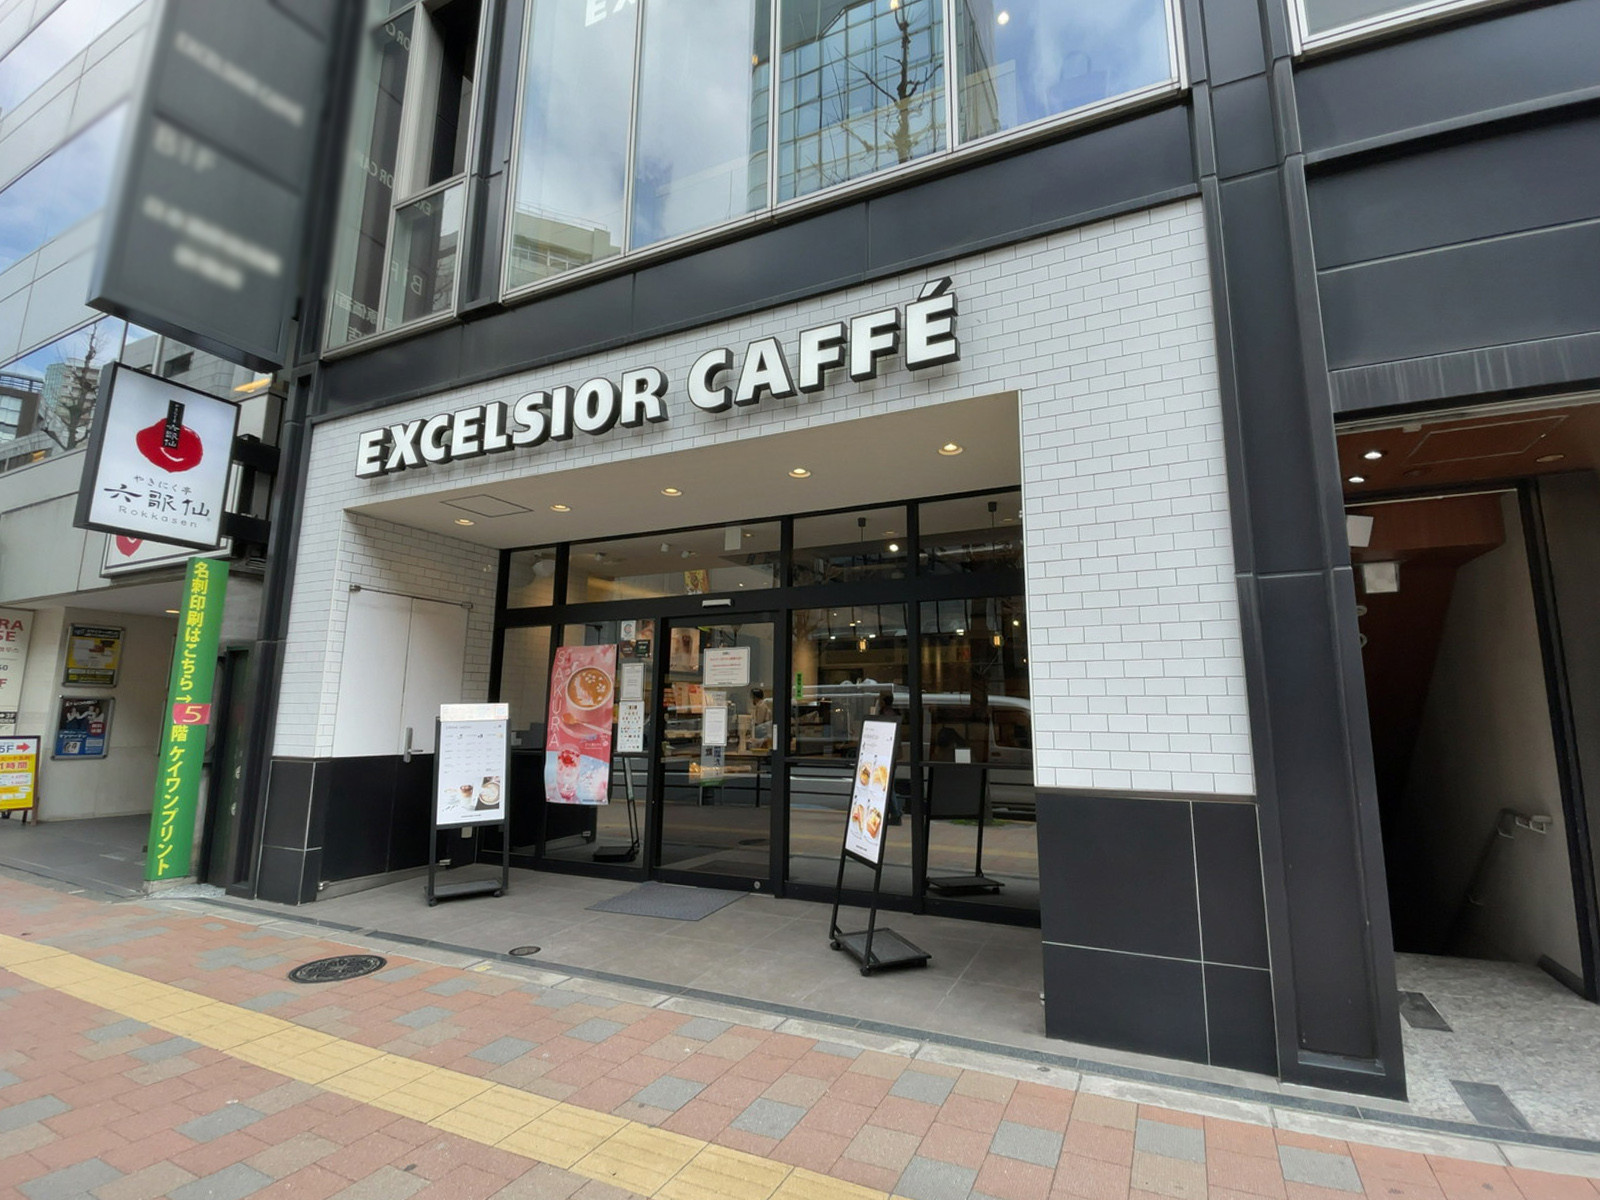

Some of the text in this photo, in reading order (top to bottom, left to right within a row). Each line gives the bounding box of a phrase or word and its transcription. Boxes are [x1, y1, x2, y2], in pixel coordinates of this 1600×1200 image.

[355, 276, 961, 479] EXCELSIOR CAFFÉ
[103, 483, 210, 518] 六歌仙
[118, 504, 198, 529] Rokkasen
[133, 475, 193, 496] やきにく亭
[548, 651, 565, 747] SAKURA
[157, 746, 186, 876] ケイワンプリント
